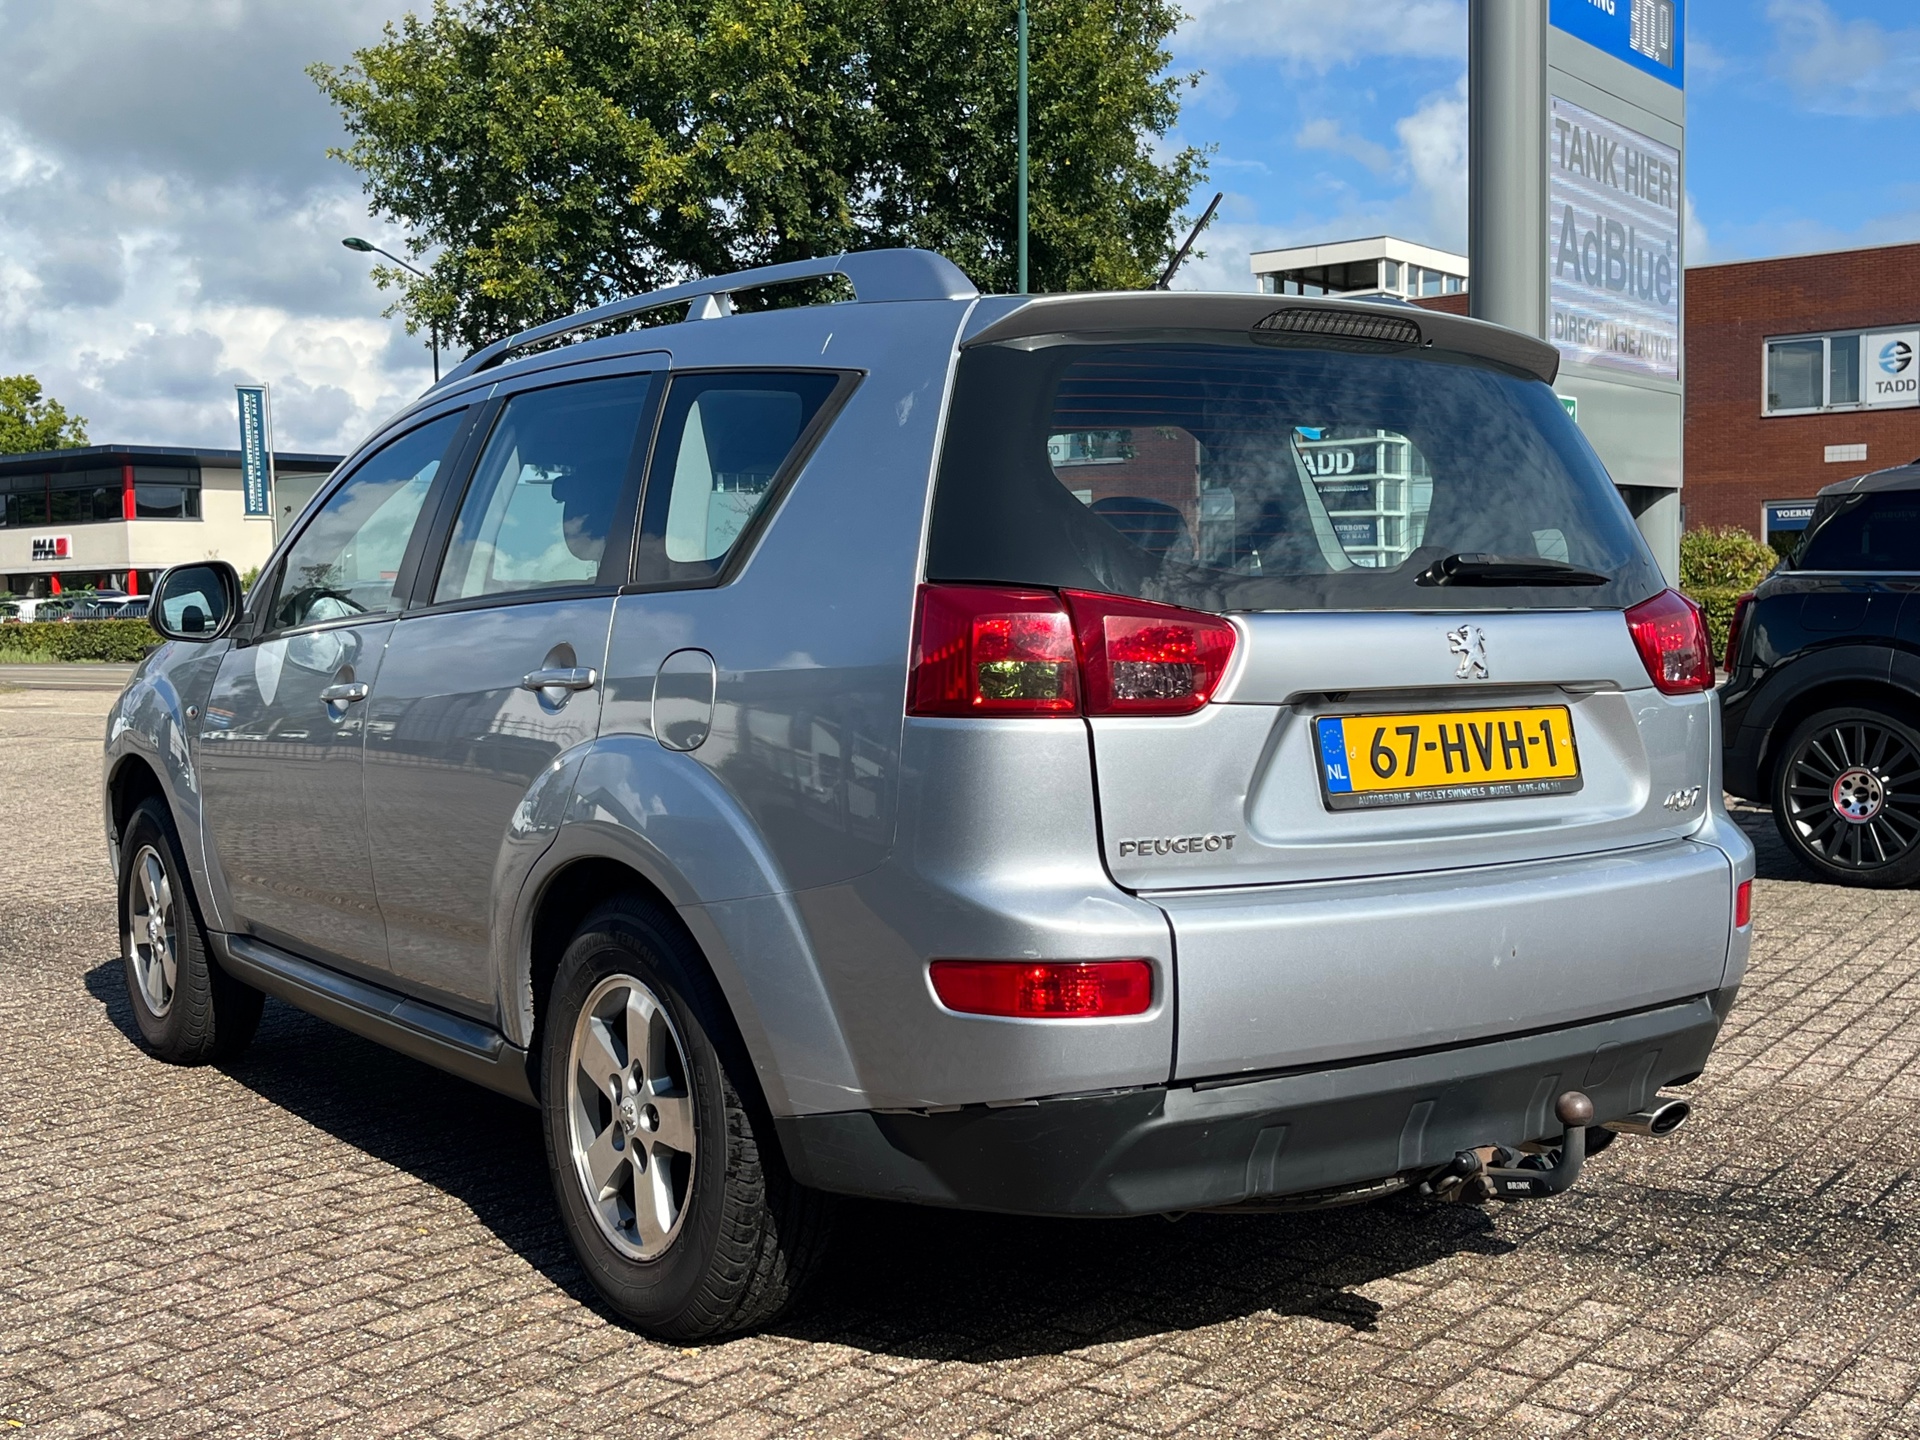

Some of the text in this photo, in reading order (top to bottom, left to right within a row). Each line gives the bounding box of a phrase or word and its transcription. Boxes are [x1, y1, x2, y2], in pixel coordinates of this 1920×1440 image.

[1555, 118, 1673, 209] TANK HIER
[1555, 312, 1602, 347] DIRECT
[1606, 324, 1618, 351] IN
[1620, 328, 1636, 354] JE
[1875, 379, 1917, 393] TADD
[252, 416, 259, 428] OP
[243, 392, 256, 511] VOERMANS INTERIEURBOUW
[1776, 508, 1815, 518] VOERM
[1369, 719, 1558, 779] 67-HVH-1
[1327, 764, 1347, 781] NL
[1415, 789, 1447, 801] WESLEY
[1447, 786, 1486, 799] SWINKELS
[1489, 784, 1514, 796] BUDEL
[1119, 832, 1237, 857] PEUGEOT
[1506, 1181, 1531, 1190] BRINK
